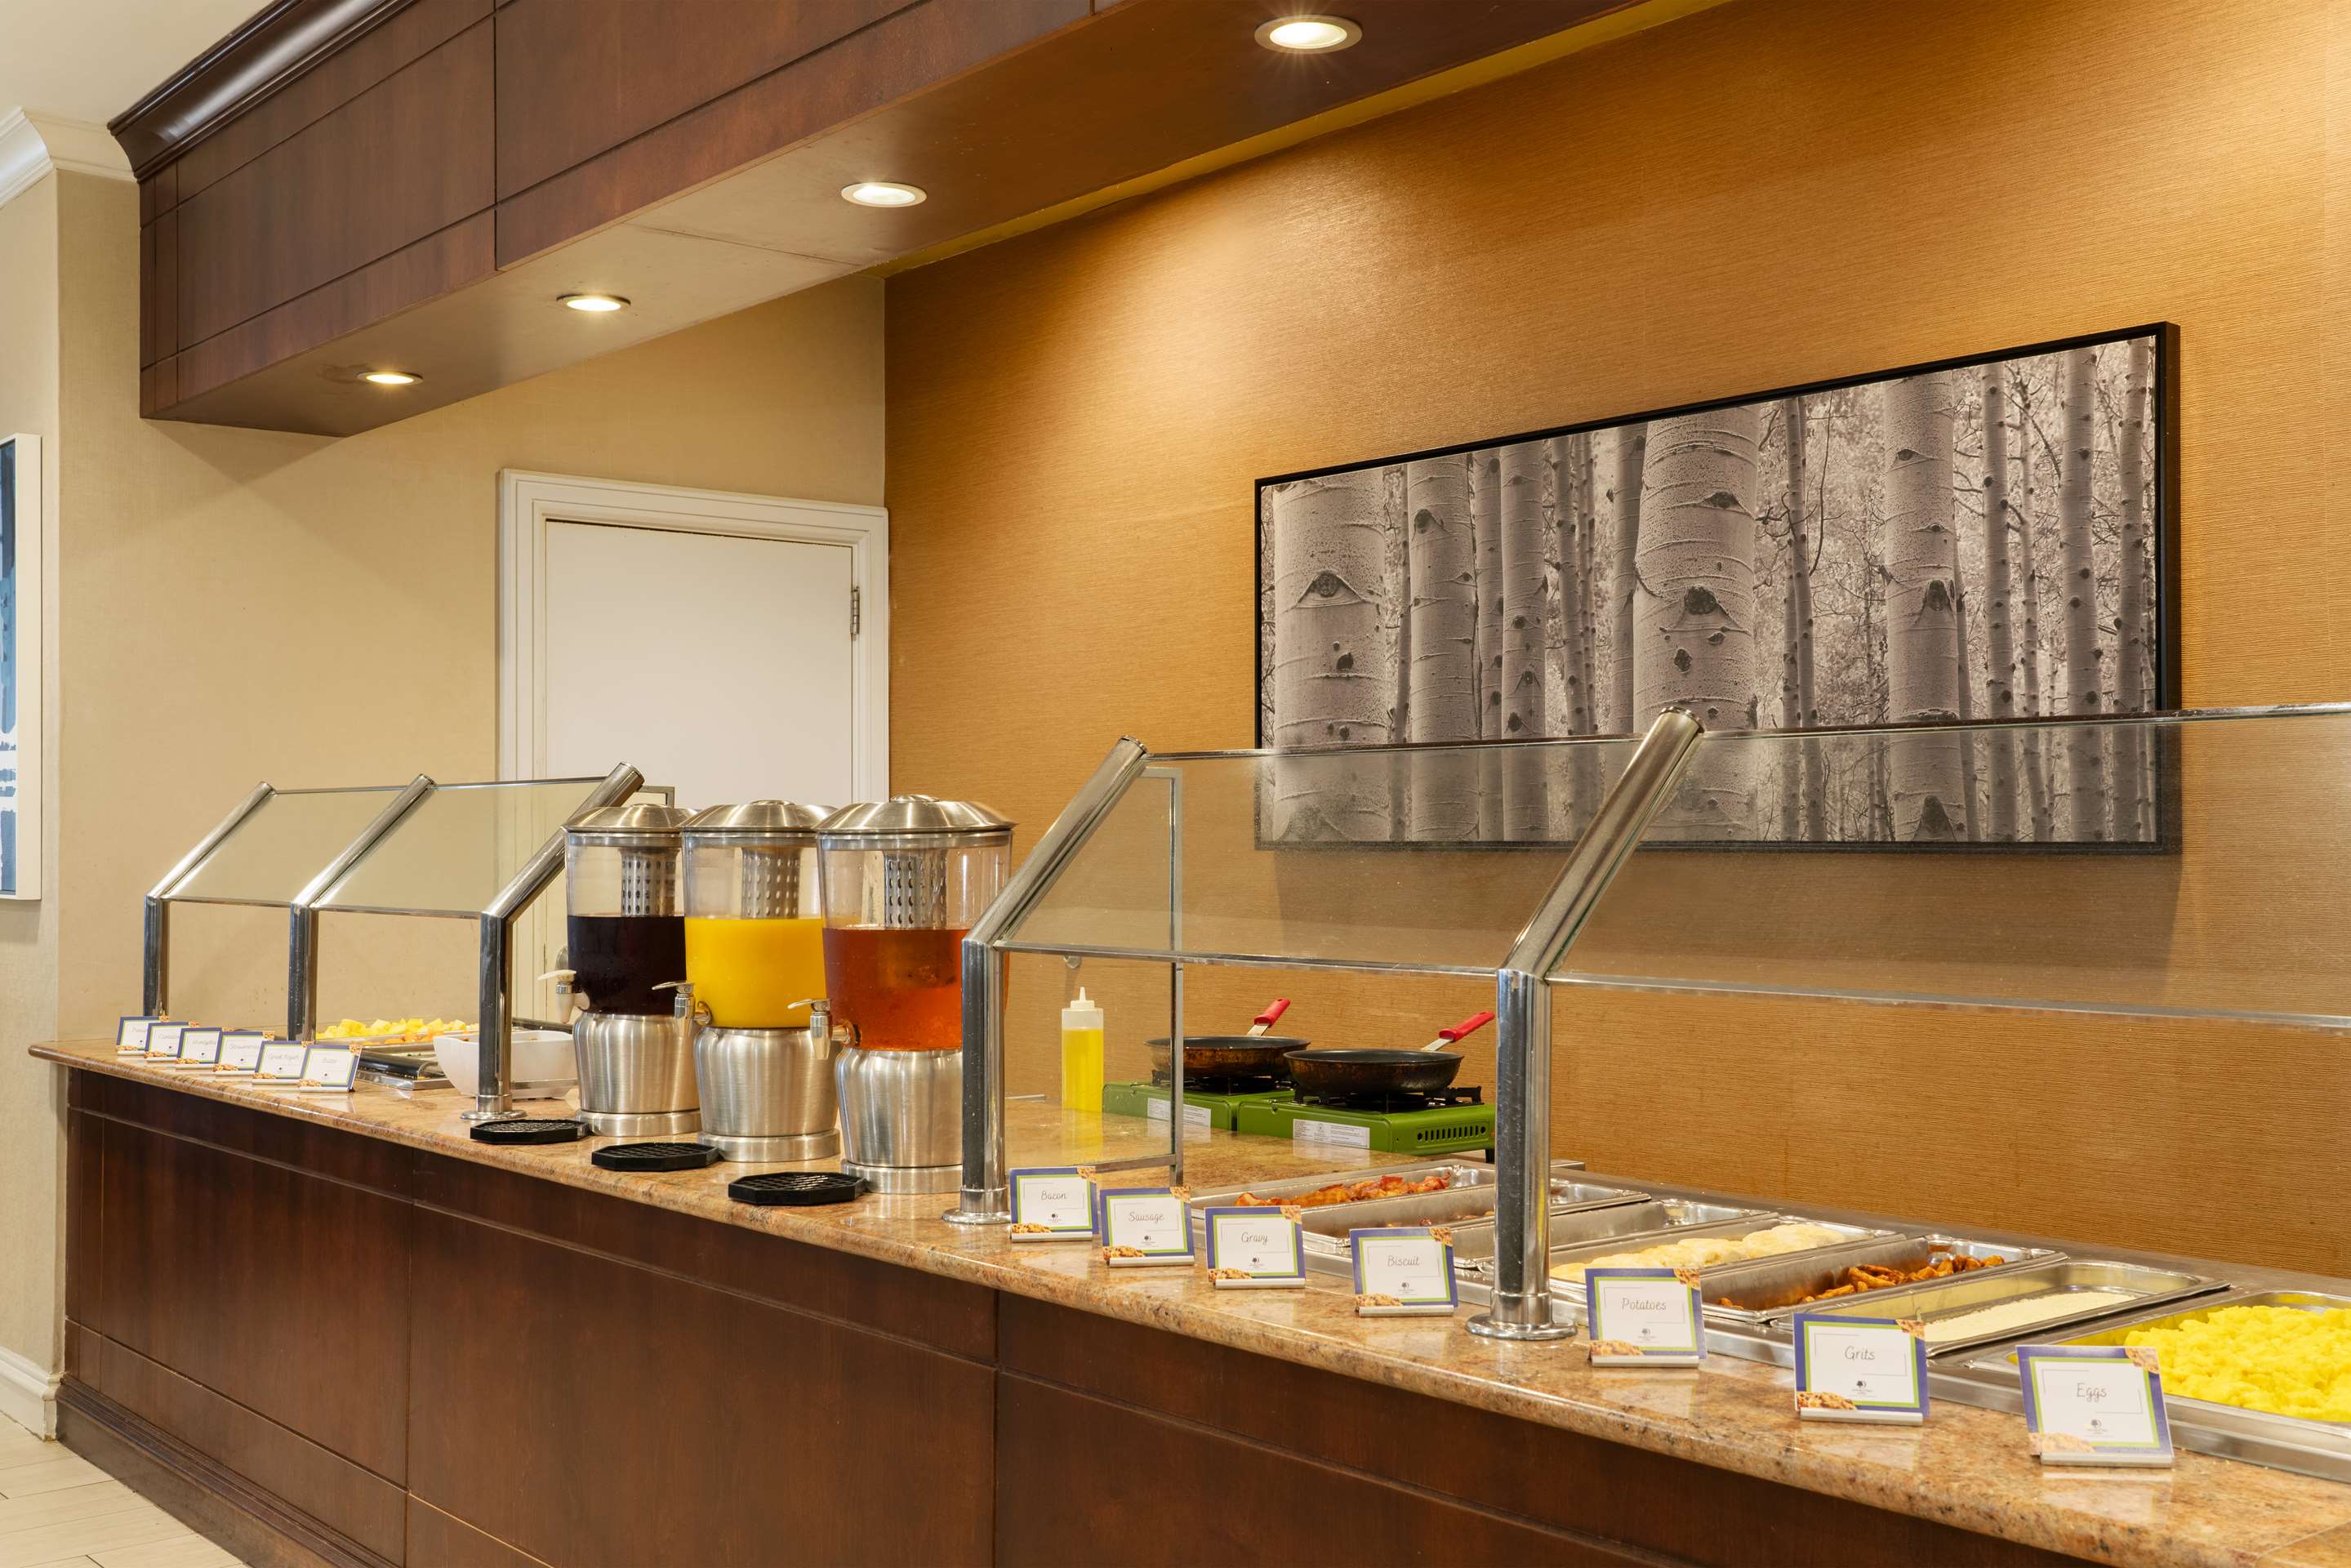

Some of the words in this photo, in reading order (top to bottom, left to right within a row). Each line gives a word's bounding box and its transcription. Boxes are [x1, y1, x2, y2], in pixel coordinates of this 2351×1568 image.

[1040, 1189, 1067, 1202] Bacon
[1128, 1210, 1165, 1224] Sausage
[1240, 1231, 1269, 1246] Gravy
[1387, 1254, 1421, 1267] Biscuit
[1621, 1297, 1667, 1312] Potatoes
[1844, 1345, 1877, 1361] Grits
[2075, 1381, 2108, 1402] Eggs
